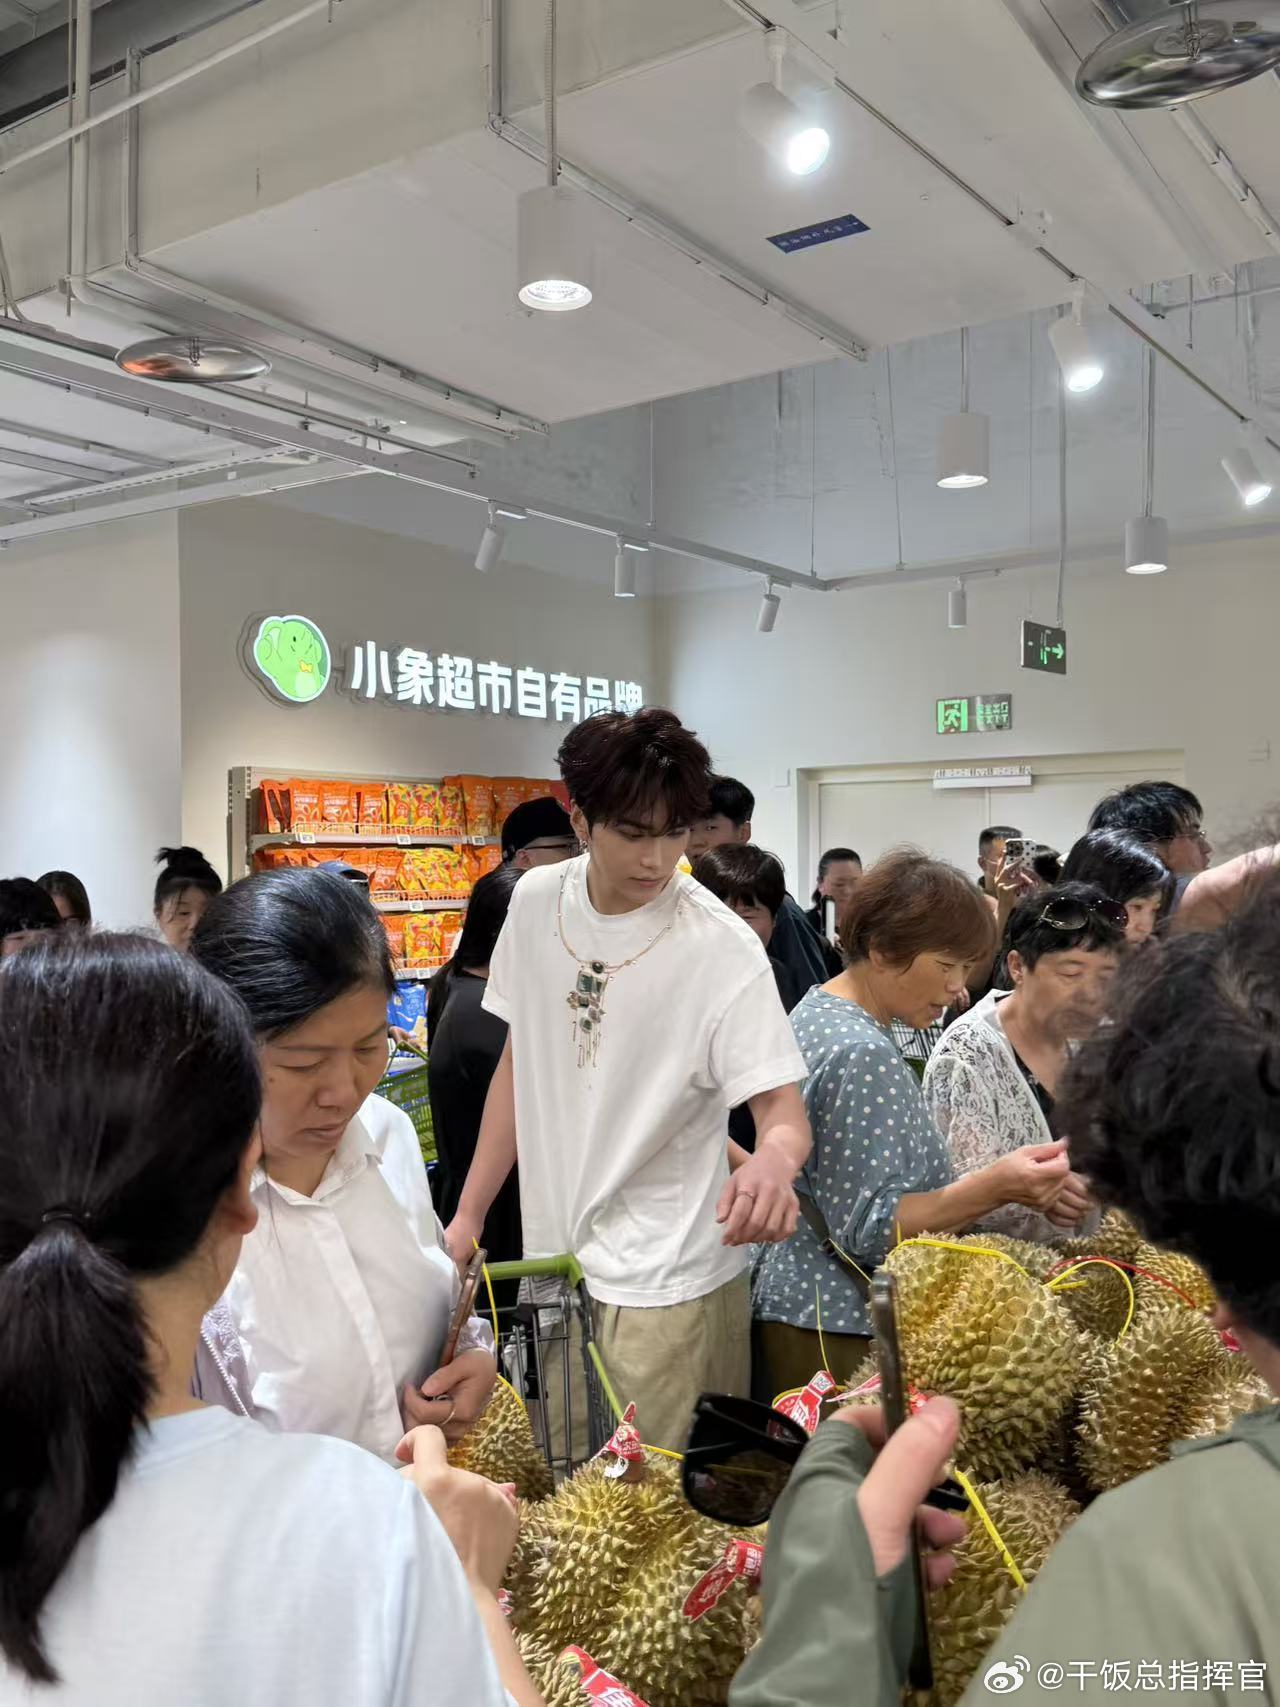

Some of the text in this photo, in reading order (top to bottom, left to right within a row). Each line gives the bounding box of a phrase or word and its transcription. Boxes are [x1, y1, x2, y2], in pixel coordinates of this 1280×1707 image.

[351, 641, 643, 723] 小象超市自有品牌
